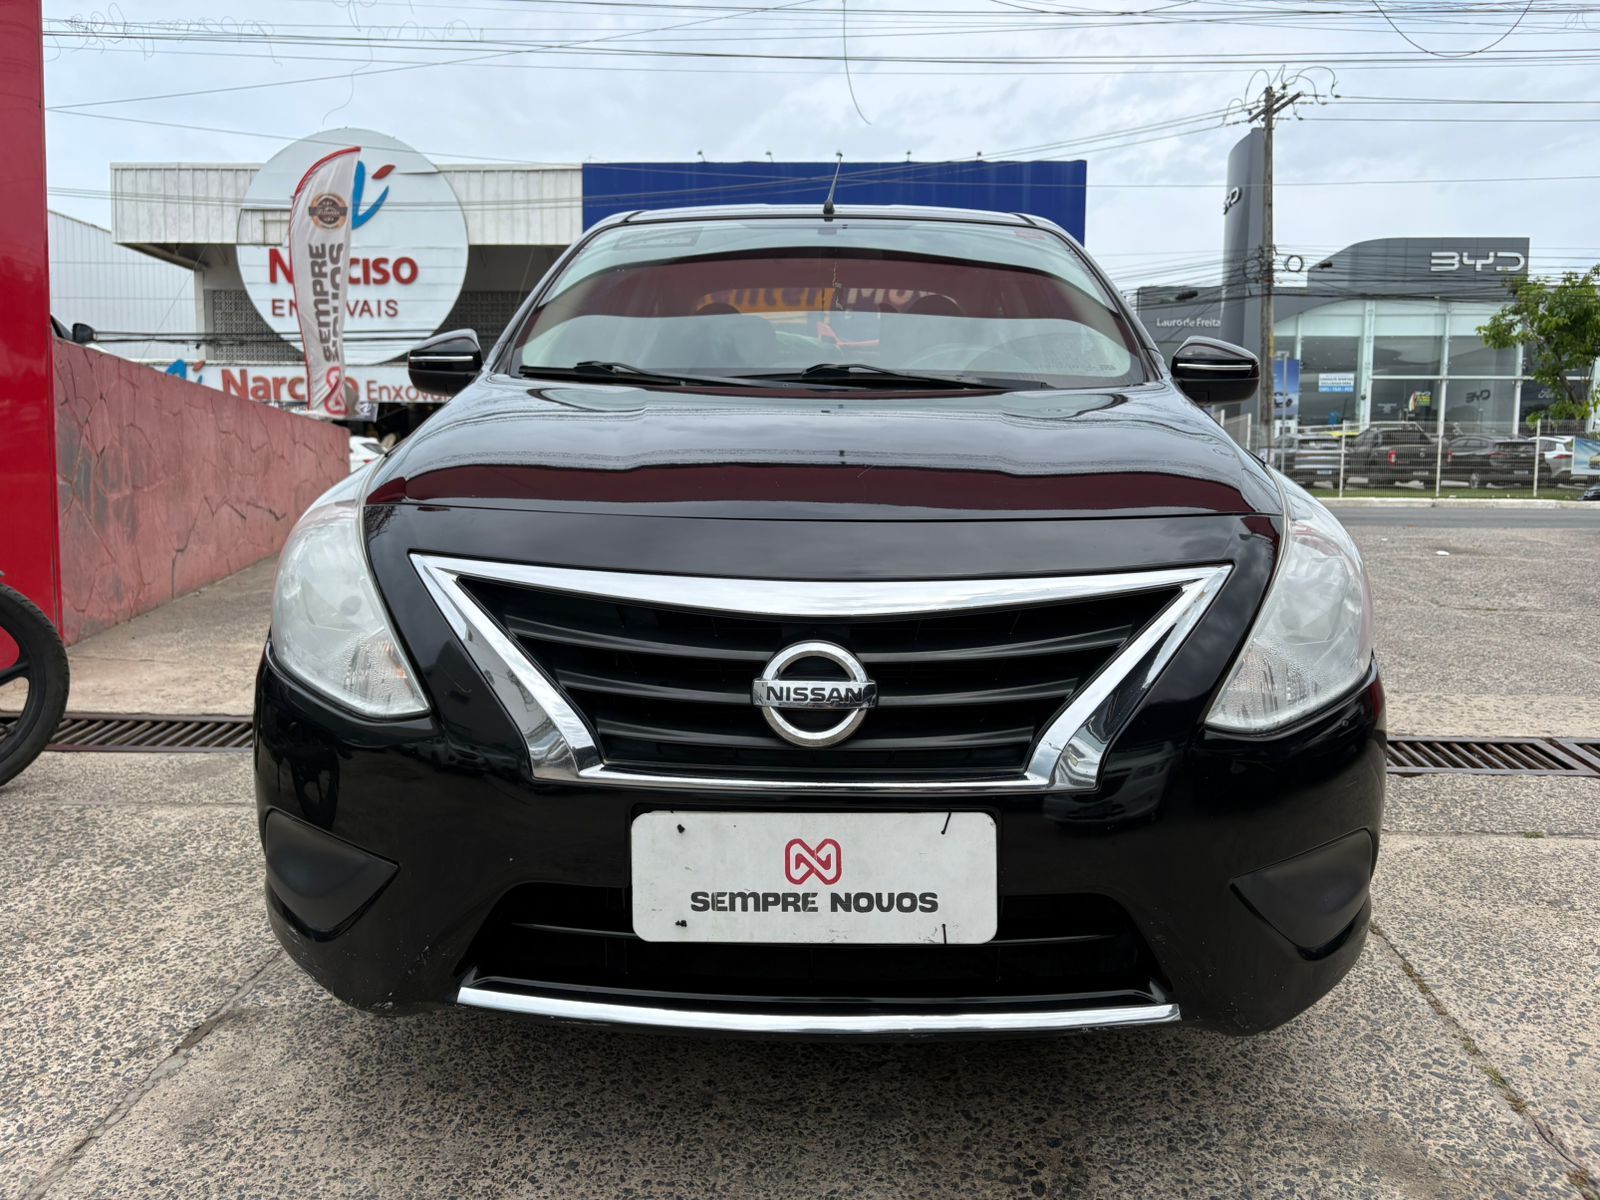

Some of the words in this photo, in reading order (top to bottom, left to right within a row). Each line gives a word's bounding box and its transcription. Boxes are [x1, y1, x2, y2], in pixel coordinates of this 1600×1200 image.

[268, 247, 419, 286] NCISO
[1430, 251, 1525, 272] BYD
[271, 298, 399, 318] ENVAIS
[308, 243, 331, 362] SEMPRE
[1156, 317, 1183, 327] Lauro
[1183, 317, 1195, 327] de
[1196, 317, 1221, 327] Freita
[221, 368, 359, 400] Narc
[766, 686, 863, 703] NISSAN
[690, 891, 818, 913] SEMPRE
[830, 891, 939, 913] NOVOS
